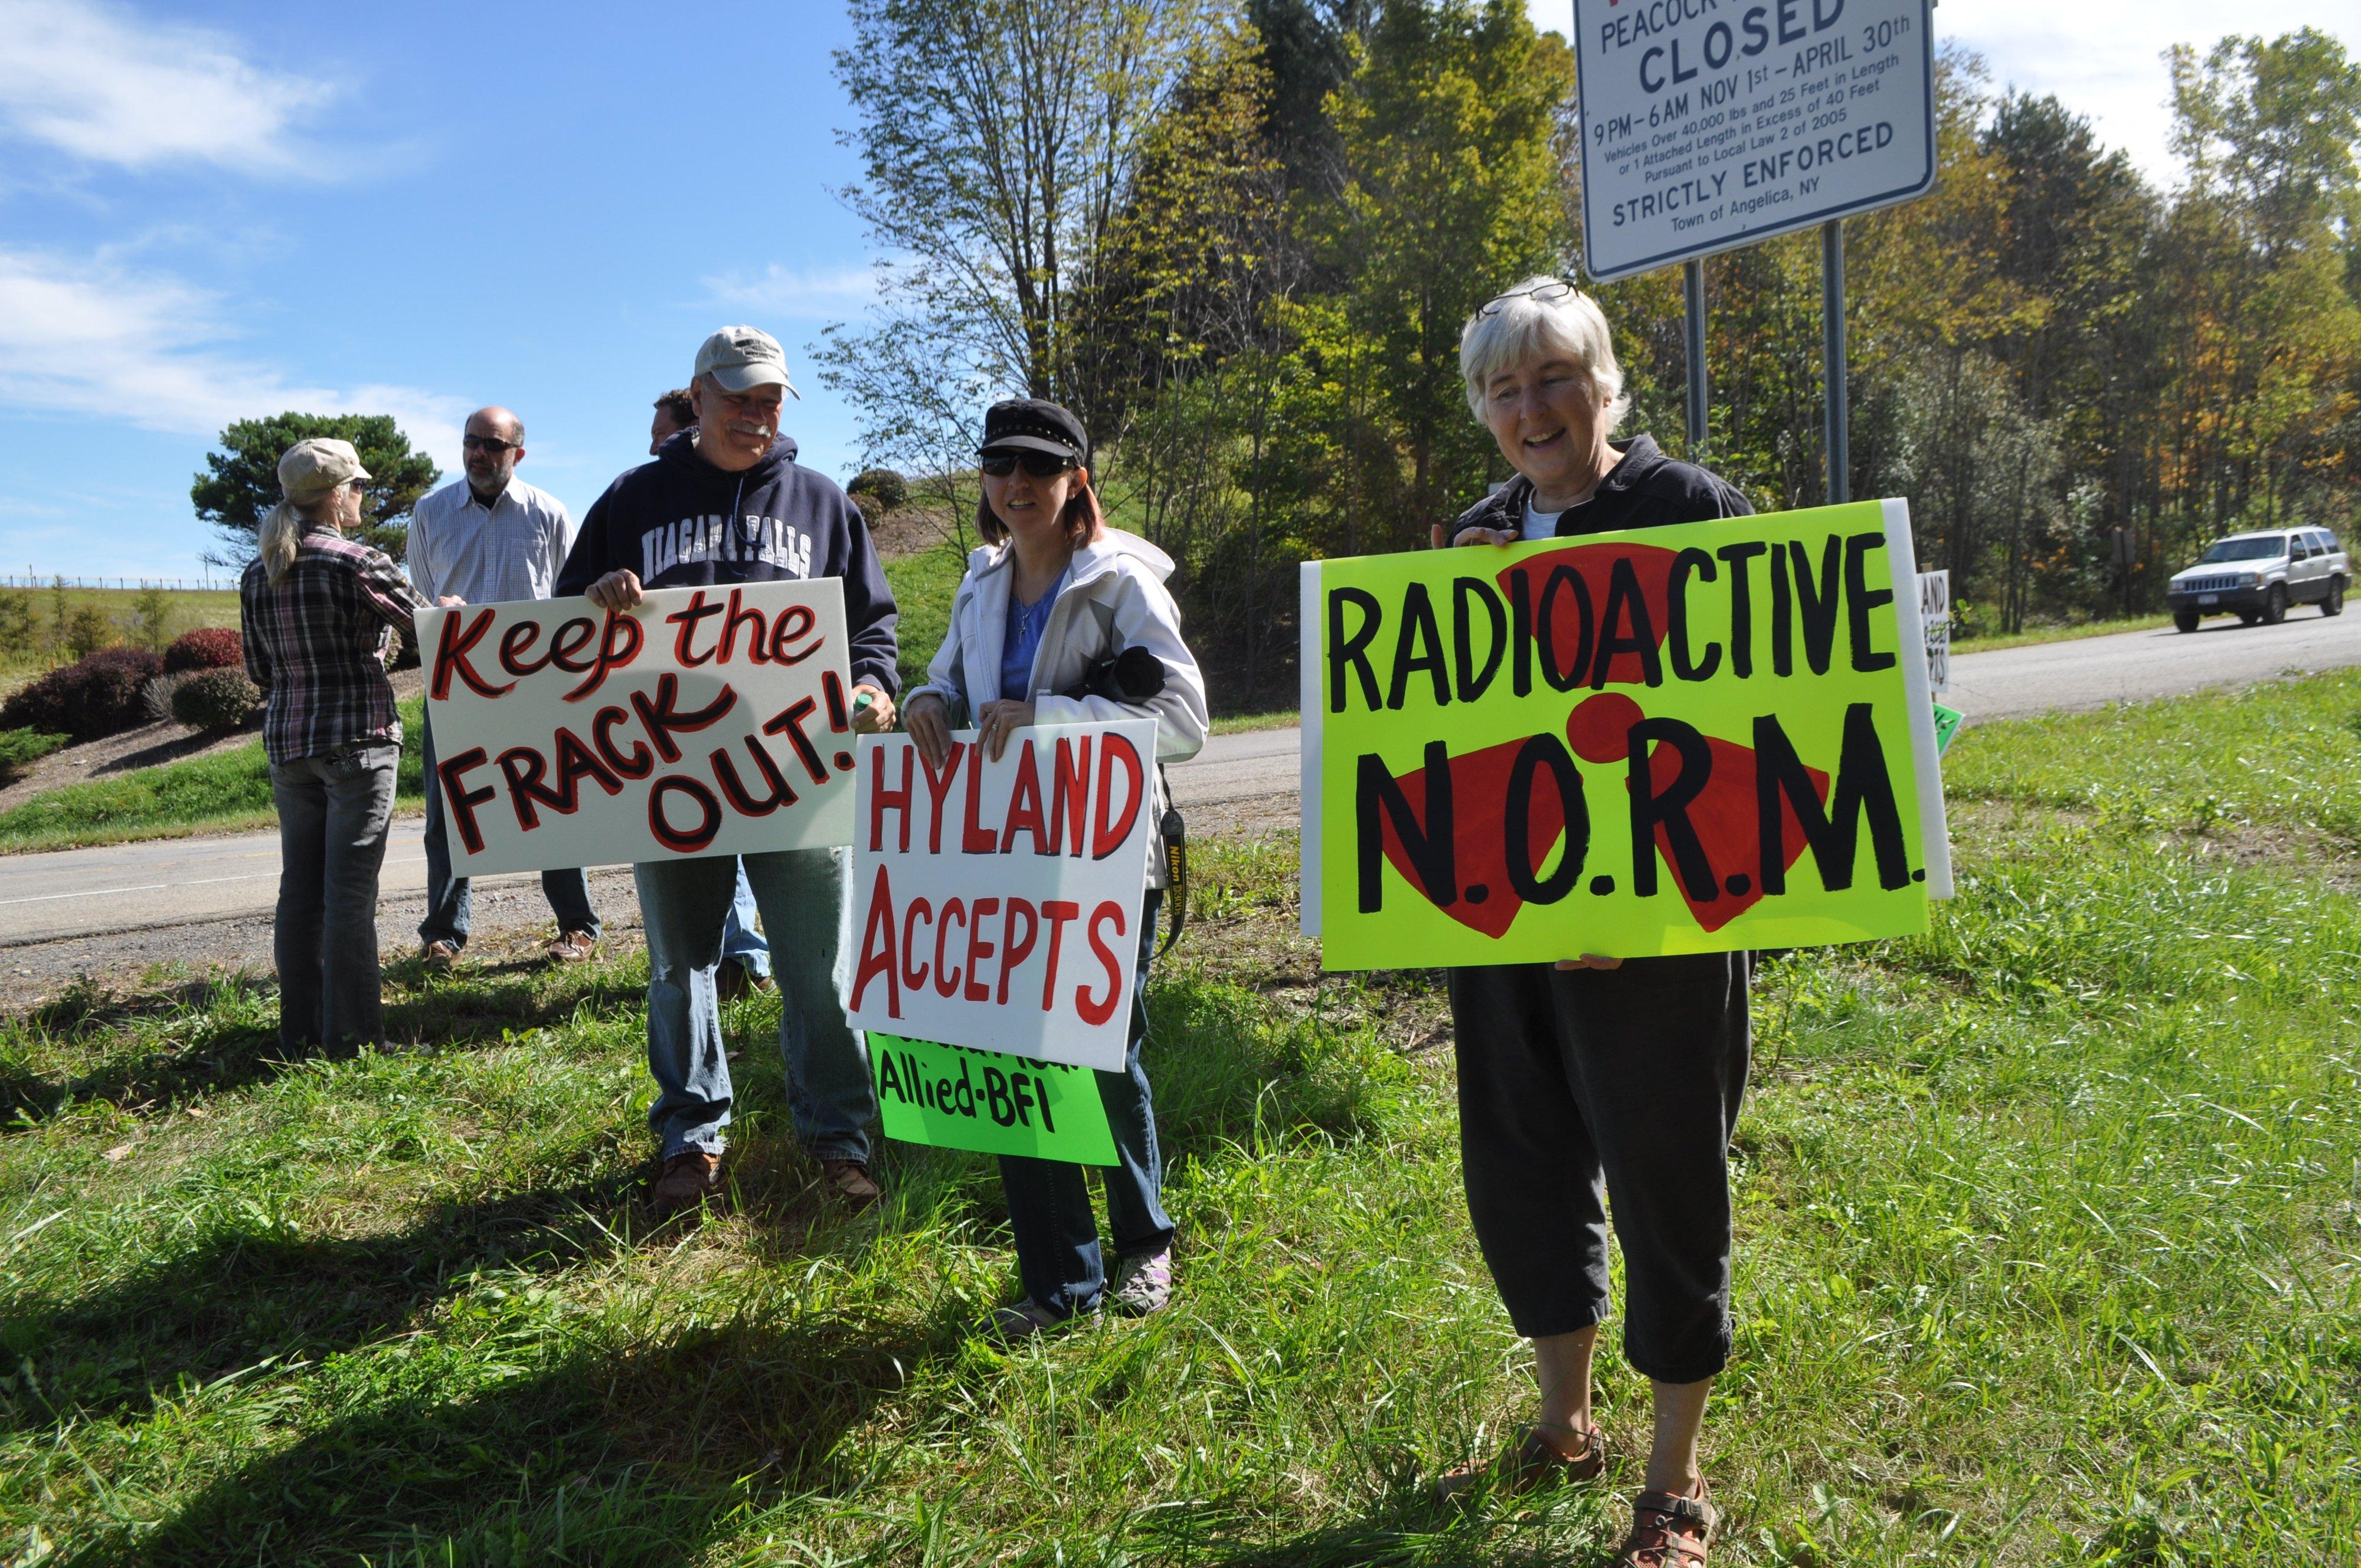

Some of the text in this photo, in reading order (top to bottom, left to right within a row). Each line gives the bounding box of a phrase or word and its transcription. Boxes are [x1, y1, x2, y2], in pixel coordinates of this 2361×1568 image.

[1640, 0, 1845, 93] CLOSED
[1701, 74, 1738, 110] NOV
[1863, 15, 1909, 53] 30th
[1604, 53, 1899, 163] Vehicles Over 40,000 lbs and 25 Feet in Length
[1618, 163, 1630, 175] or
[1643, 141, 1692, 168] Attached
[1697, 127, 1737, 149] Length
[1741, 122, 1752, 135] in
[1757, 106, 1801, 130] Excess
[1807, 97, 1820, 113] of
[1826, 90, 1844, 106] 40
[1850, 78, 1880, 99] Feet
[1644, 107, 1847, 184] Pursuant to Local Law 2 of 2005
[1613, 121, 1894, 227] STRICTLY ENFORCED
[1671, 176, 1820, 232] Town of Angelica, NY
[642, 514, 811, 587] NIAGARA FALLS
[430, 587, 825, 702] Keep the
[1327, 532, 1897, 713] RADIOACTIVE
[437, 672, 737, 855] FRACK
[649, 670, 855, 853] OUT!
[869, 732, 1144, 860] HYLAND
[1356, 702, 1927, 914] N.O.R.M.
[1169, 846, 1180, 882] Nikon
[849, 863, 1126, 1026] ACCEPTS
